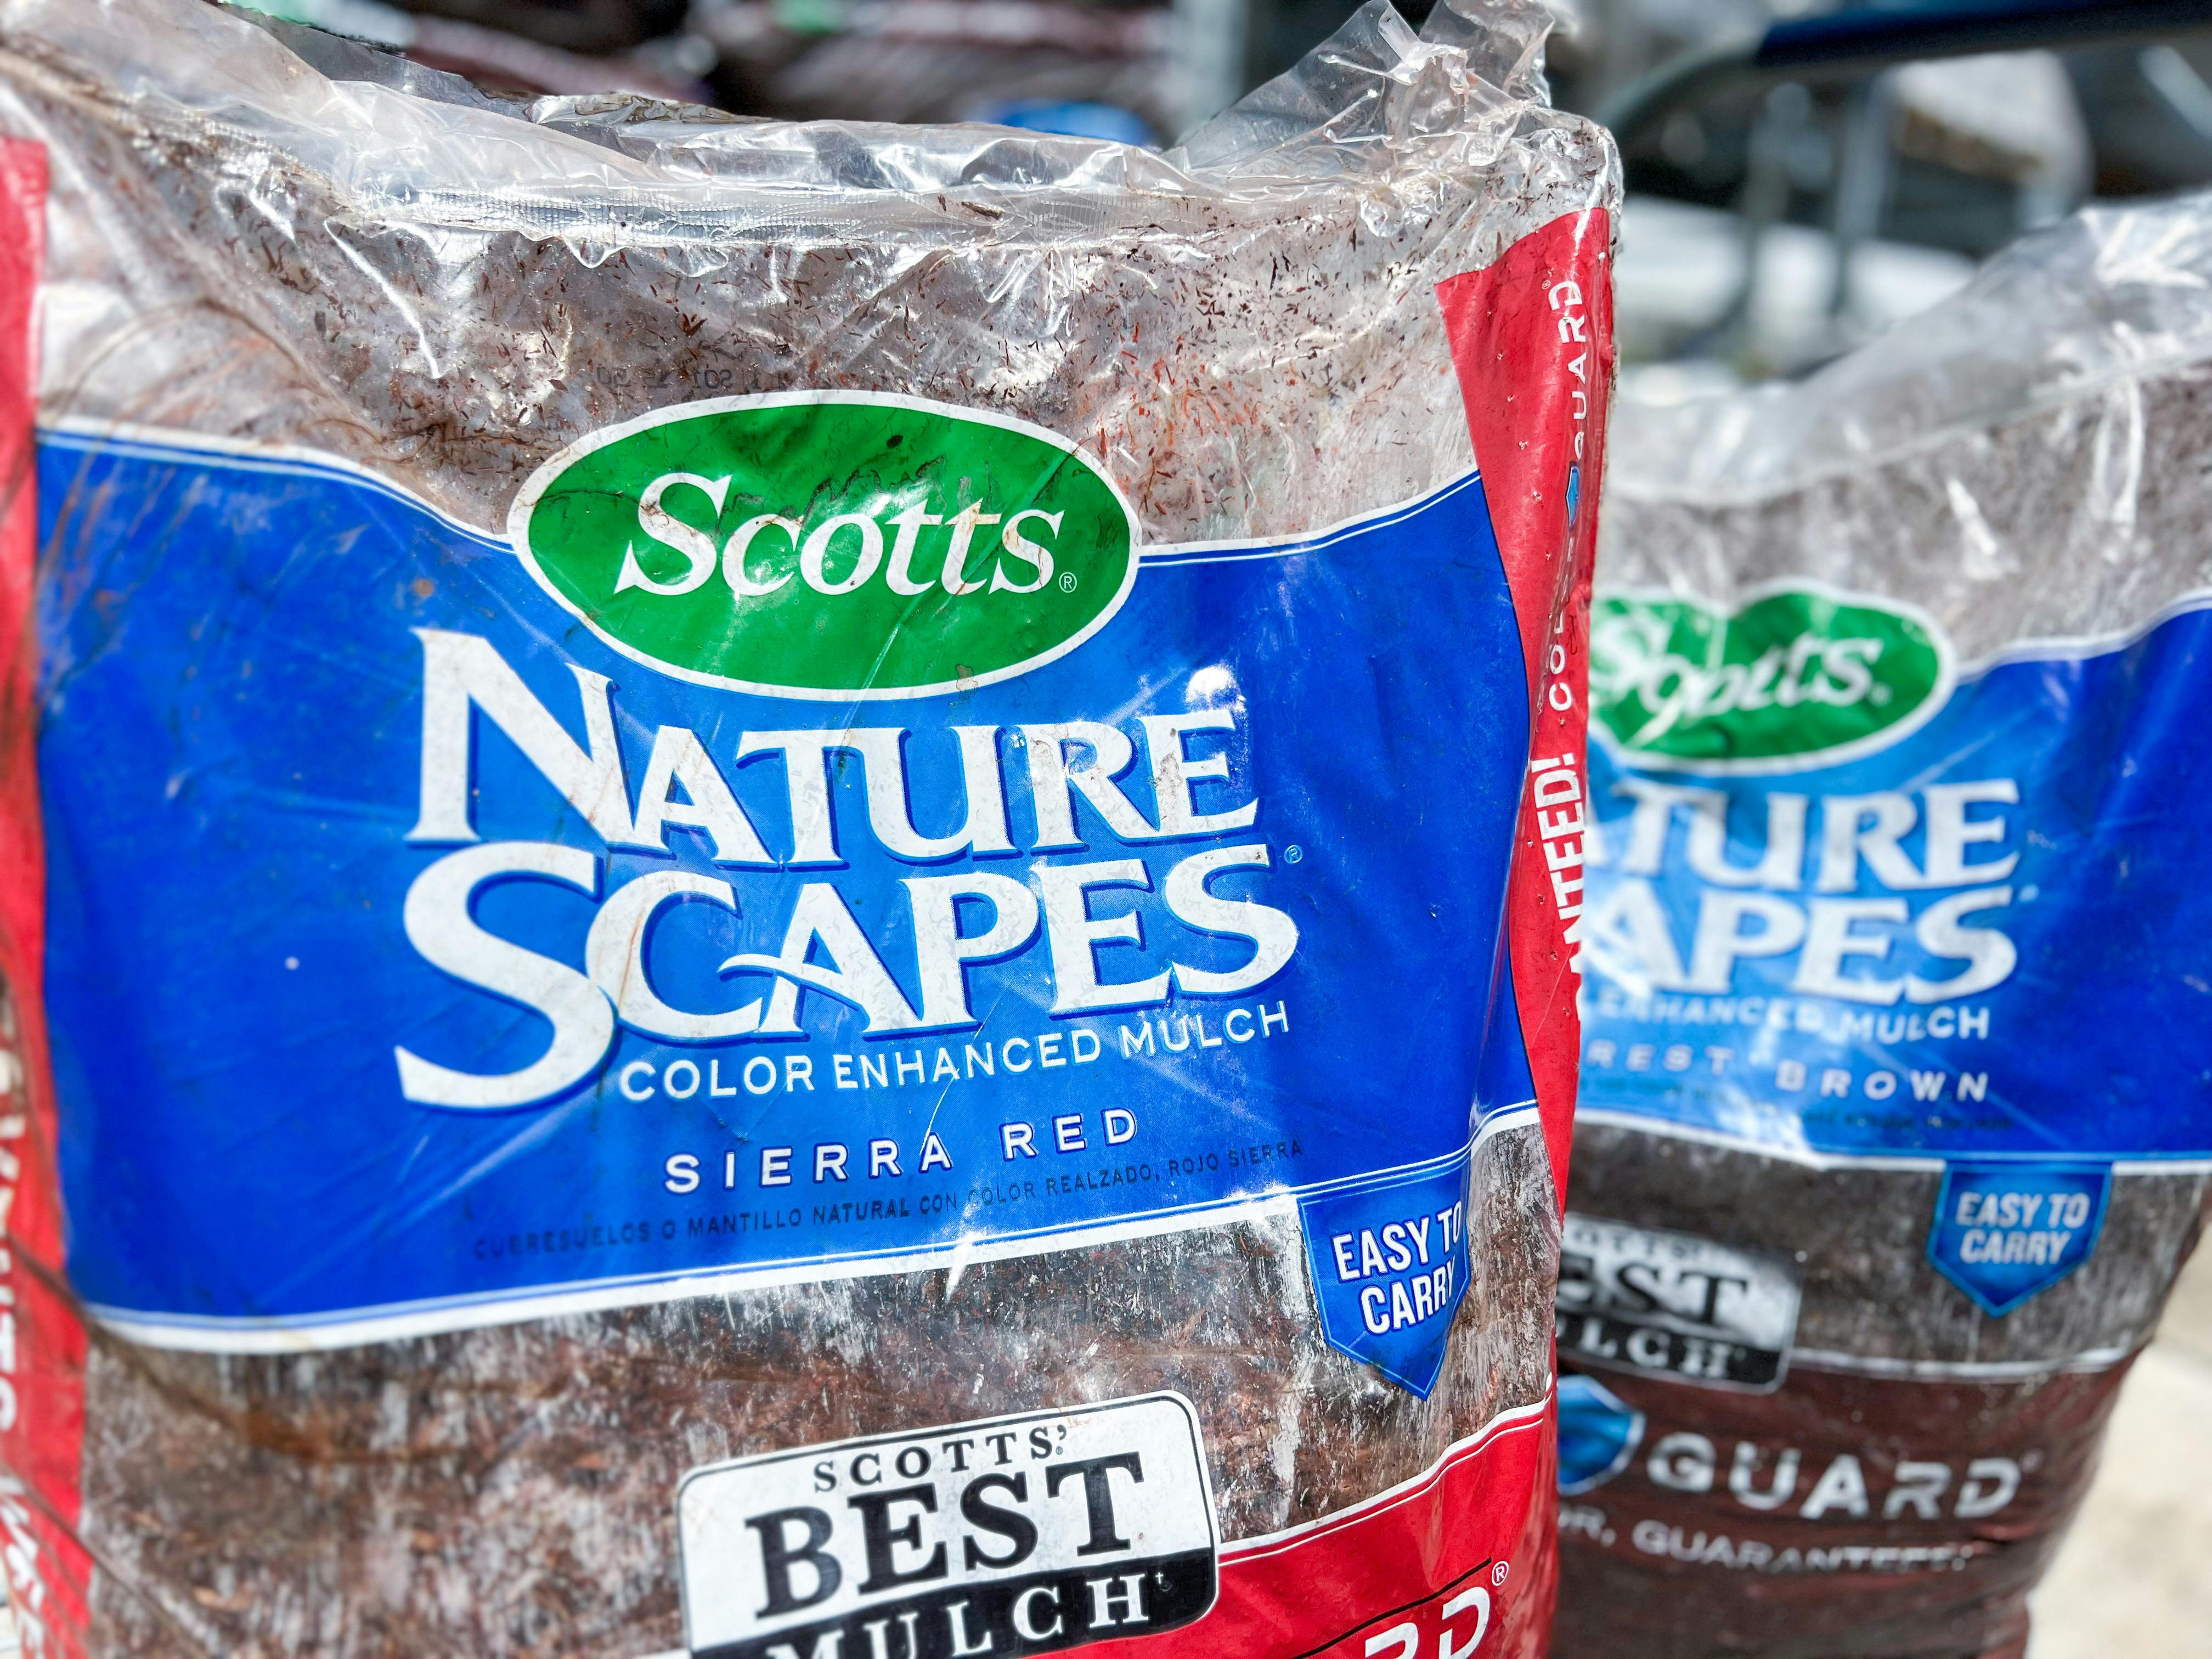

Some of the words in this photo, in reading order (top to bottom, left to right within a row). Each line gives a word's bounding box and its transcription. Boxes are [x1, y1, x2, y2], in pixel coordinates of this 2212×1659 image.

[613, 472, 1065, 597] Scotts
[405, 628, 1259, 868] NATURE
[394, 841, 1300, 1107] SCAPES
[620, 1053, 816, 1101] COLOR
[834, 1034, 1099, 1090] ENHANCED
[1120, 1001, 1290, 1059] MULCH
[1841, 1005, 1990, 1046] MULCH
[1775, 1058, 1989, 1103] BROWN
[664, 1132, 952, 1194] SIERRA
[1001, 1108, 1137, 1160] RED
[474, 1221, 651, 1259] CUBRESUELOS
[662, 1222, 676, 1241] O
[688, 1209, 802, 1238] MANTILLO
[814, 1197, 910, 1223] NATURAL
[919, 1192, 957, 1214] CON
[968, 1181, 1036, 1207] COLOR
[1046, 1163, 1161, 1197] REALZADO,
[1169, 1154, 1218, 1177] ROJO
[1228, 1139, 1304, 1167] SIERRA
[1333, 1217, 1430, 1280] EASY
[1437, 1200, 1462, 1253] TO
[1955, 1192, 2043, 1227] EASY
[2048, 1192, 2091, 1226] TO
[1960, 1231, 2070, 1265] CARRY
[1361, 1255, 1455, 1335] CARRY
[814, 1424, 1069, 1492] SCOTTS'
[1647, 1431, 2023, 1520] GUARD
[744, 1452, 1146, 1620] BEST
